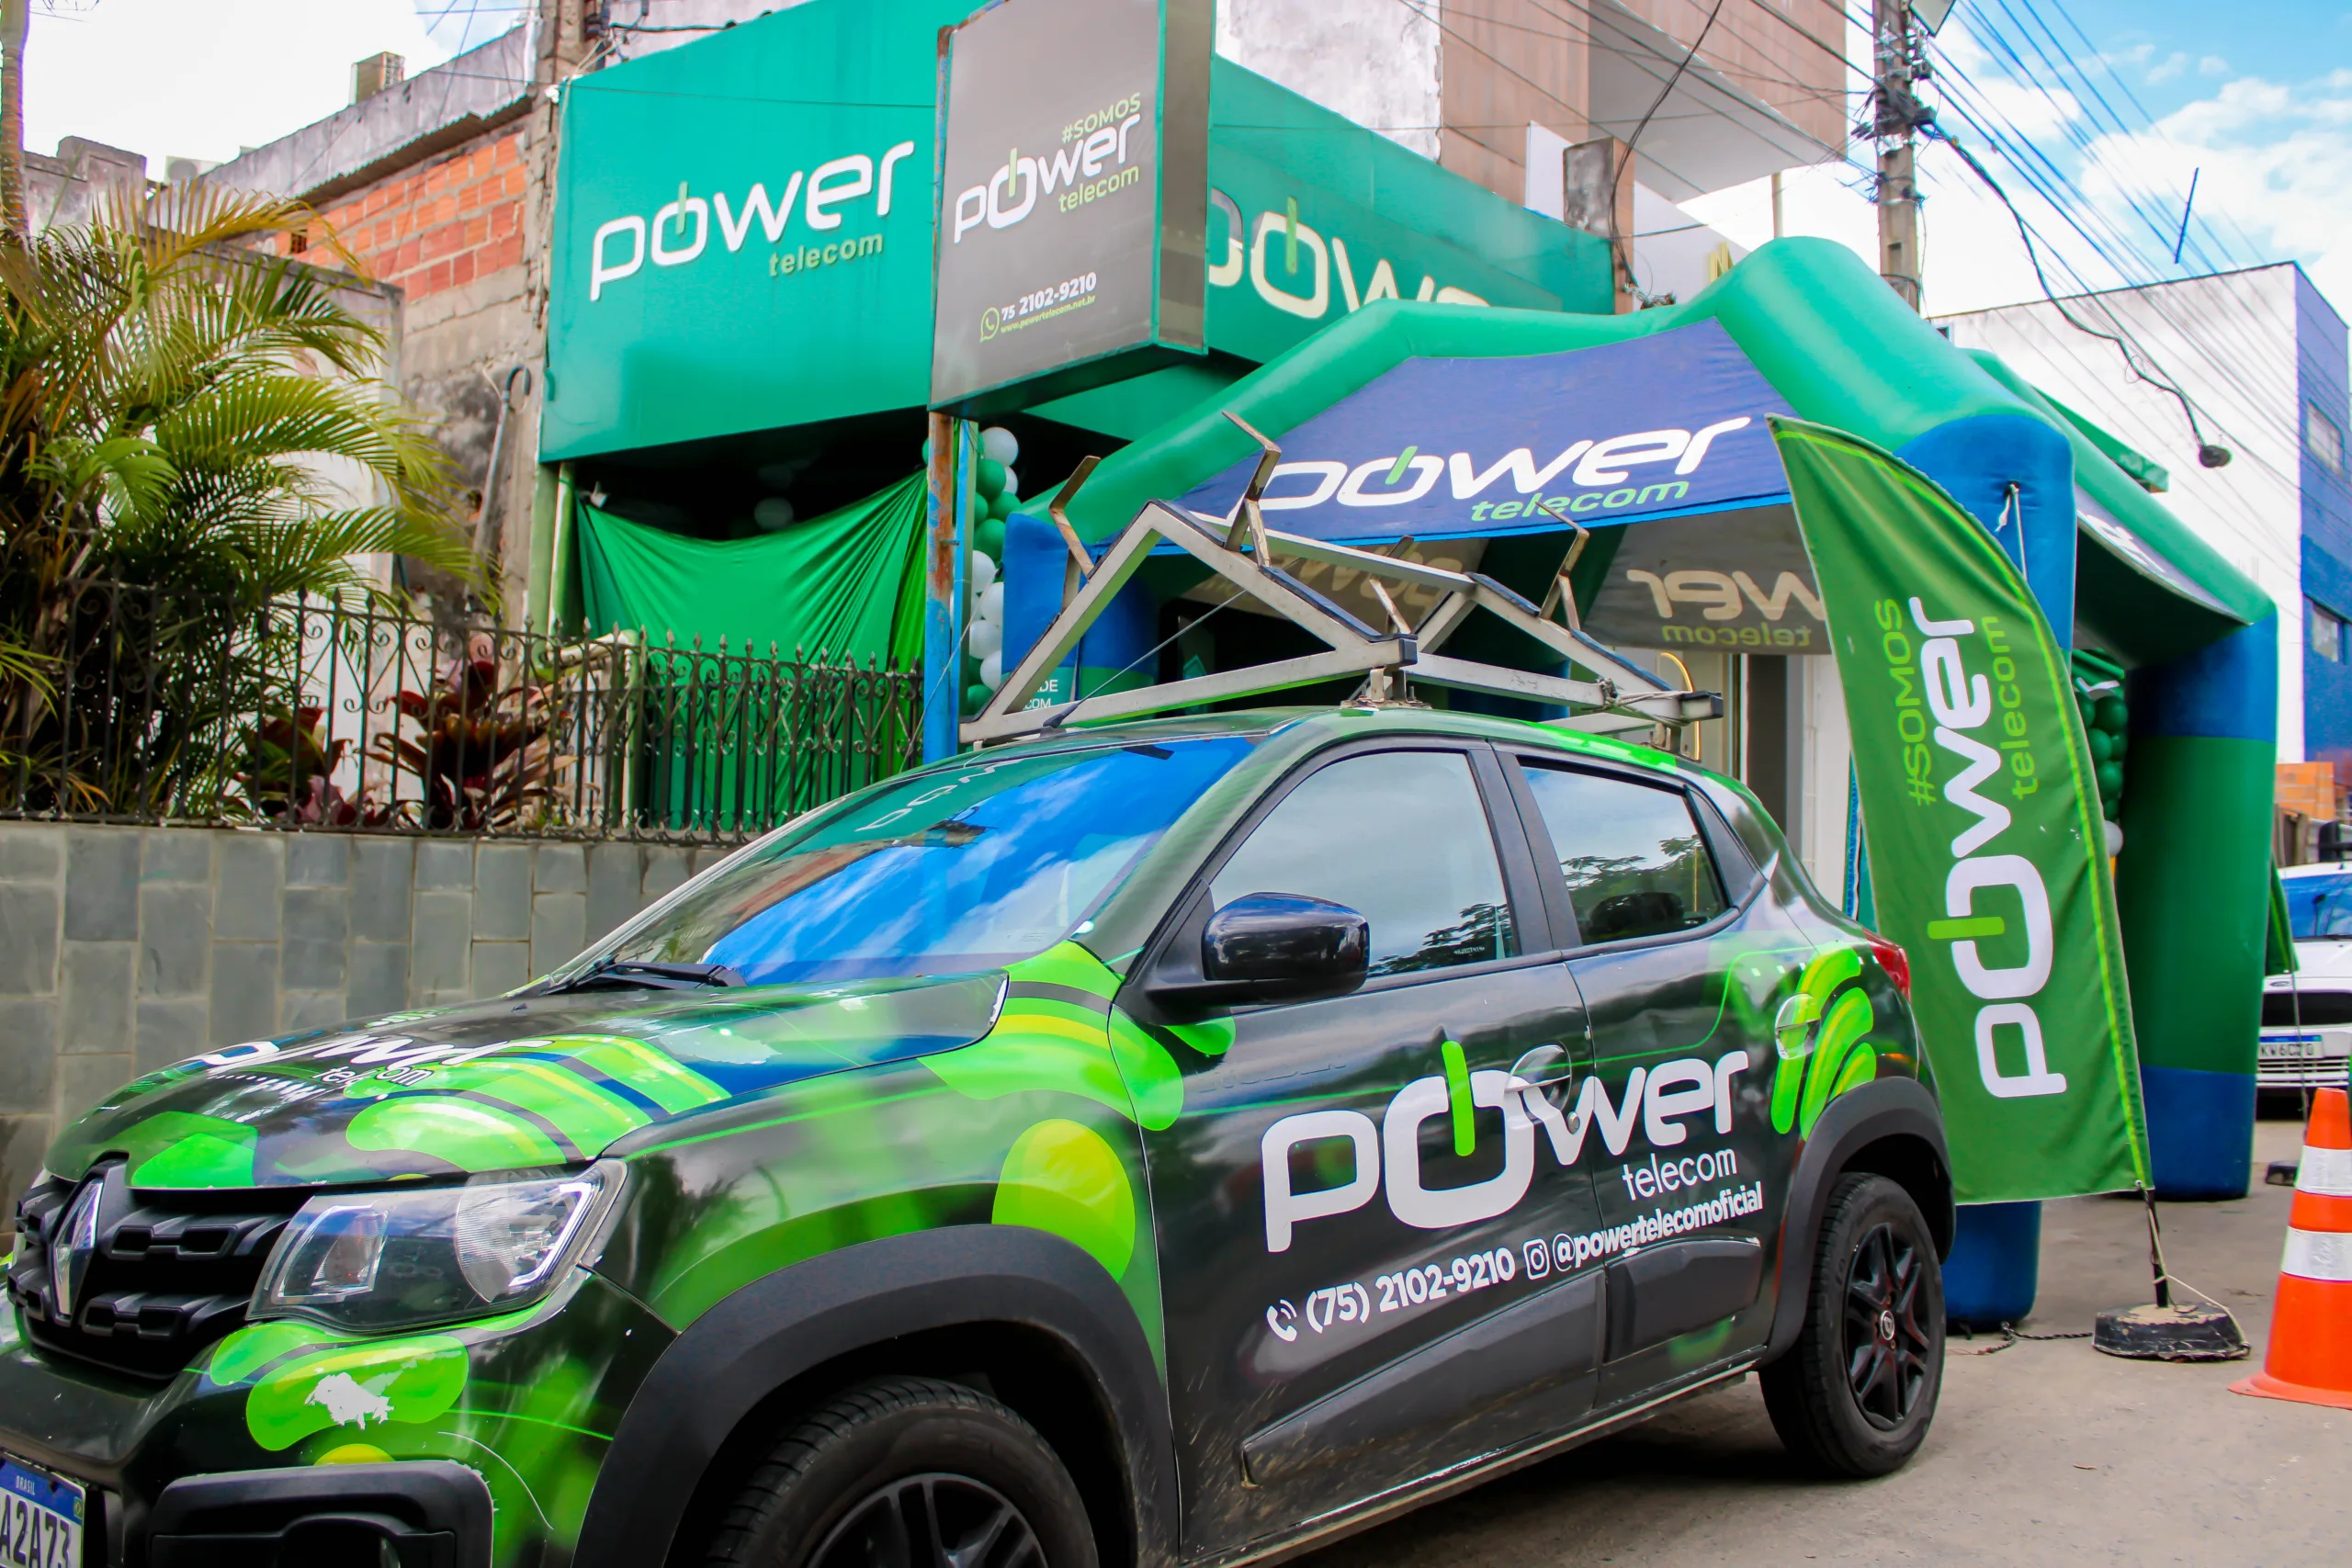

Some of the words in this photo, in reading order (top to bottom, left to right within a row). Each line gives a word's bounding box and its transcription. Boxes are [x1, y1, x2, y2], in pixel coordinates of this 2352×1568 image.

[1061, 92, 1141, 143] #SOMOS
[590, 141, 915, 302] power
[954, 113, 1141, 243] power
[1058, 165, 1139, 212] telecom
[769, 232, 884, 276] telecom
[1001, 304, 1016, 321] 75
[1019, 272, 1097, 315] 2102-9210
[1227, 416, 1751, 522] power
[1471, 481, 1690, 522] telecom
[1874, 598, 1937, 807] #SOMOS
[1981, 615, 2039, 800] telecom
[1908, 596, 2067, 1099] power
[1261, 1041, 1748, 1253] power
[1622, 1148, 1737, 1201] telecom
[1306, 1281, 1370, 1333] (75)
[1374, 1247, 1516, 1313] 2102-9210
[1553, 1180, 1763, 1272] @powertelecomoficial
[16, 1474, 36, 1495] BRASIL
